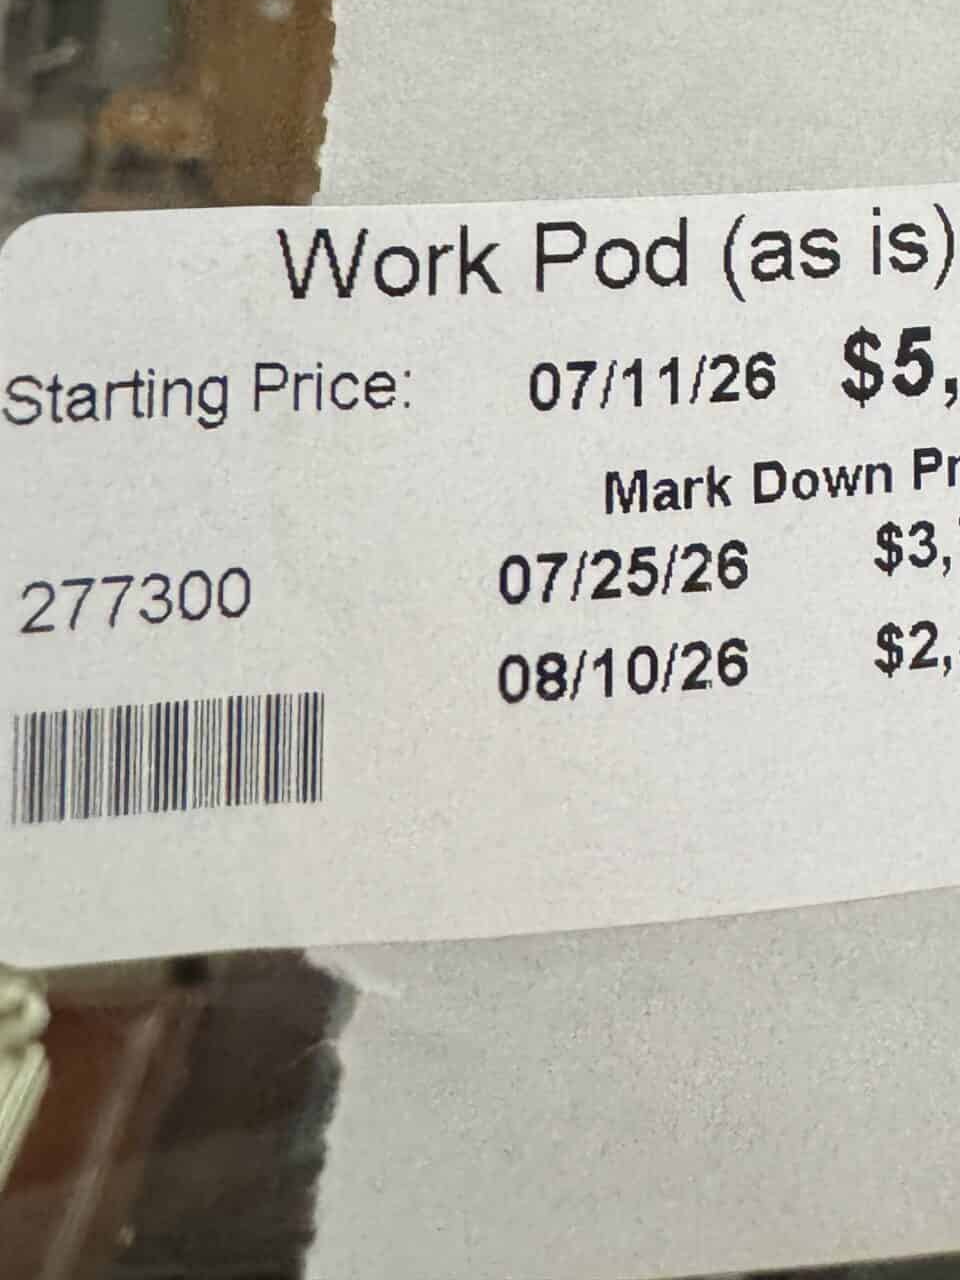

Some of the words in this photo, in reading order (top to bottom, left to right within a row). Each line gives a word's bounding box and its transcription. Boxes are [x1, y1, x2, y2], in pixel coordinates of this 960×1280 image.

[277, 225, 502, 300] Work
[535, 216, 688, 293] Pod
[723, 213, 841, 302] (as
[872, 203, 955, 291] is)
[2, 366, 228, 430] Starting
[252, 361, 411, 412] Price:
[529, 351, 777, 412] 07/11/26
[605, 465, 732, 515] Mark
[753, 460, 893, 505] Down
[19, 566, 252, 635] 277300
[499, 539, 749, 606] 07/25/26
[498, 637, 749, 705] 08/10/26
